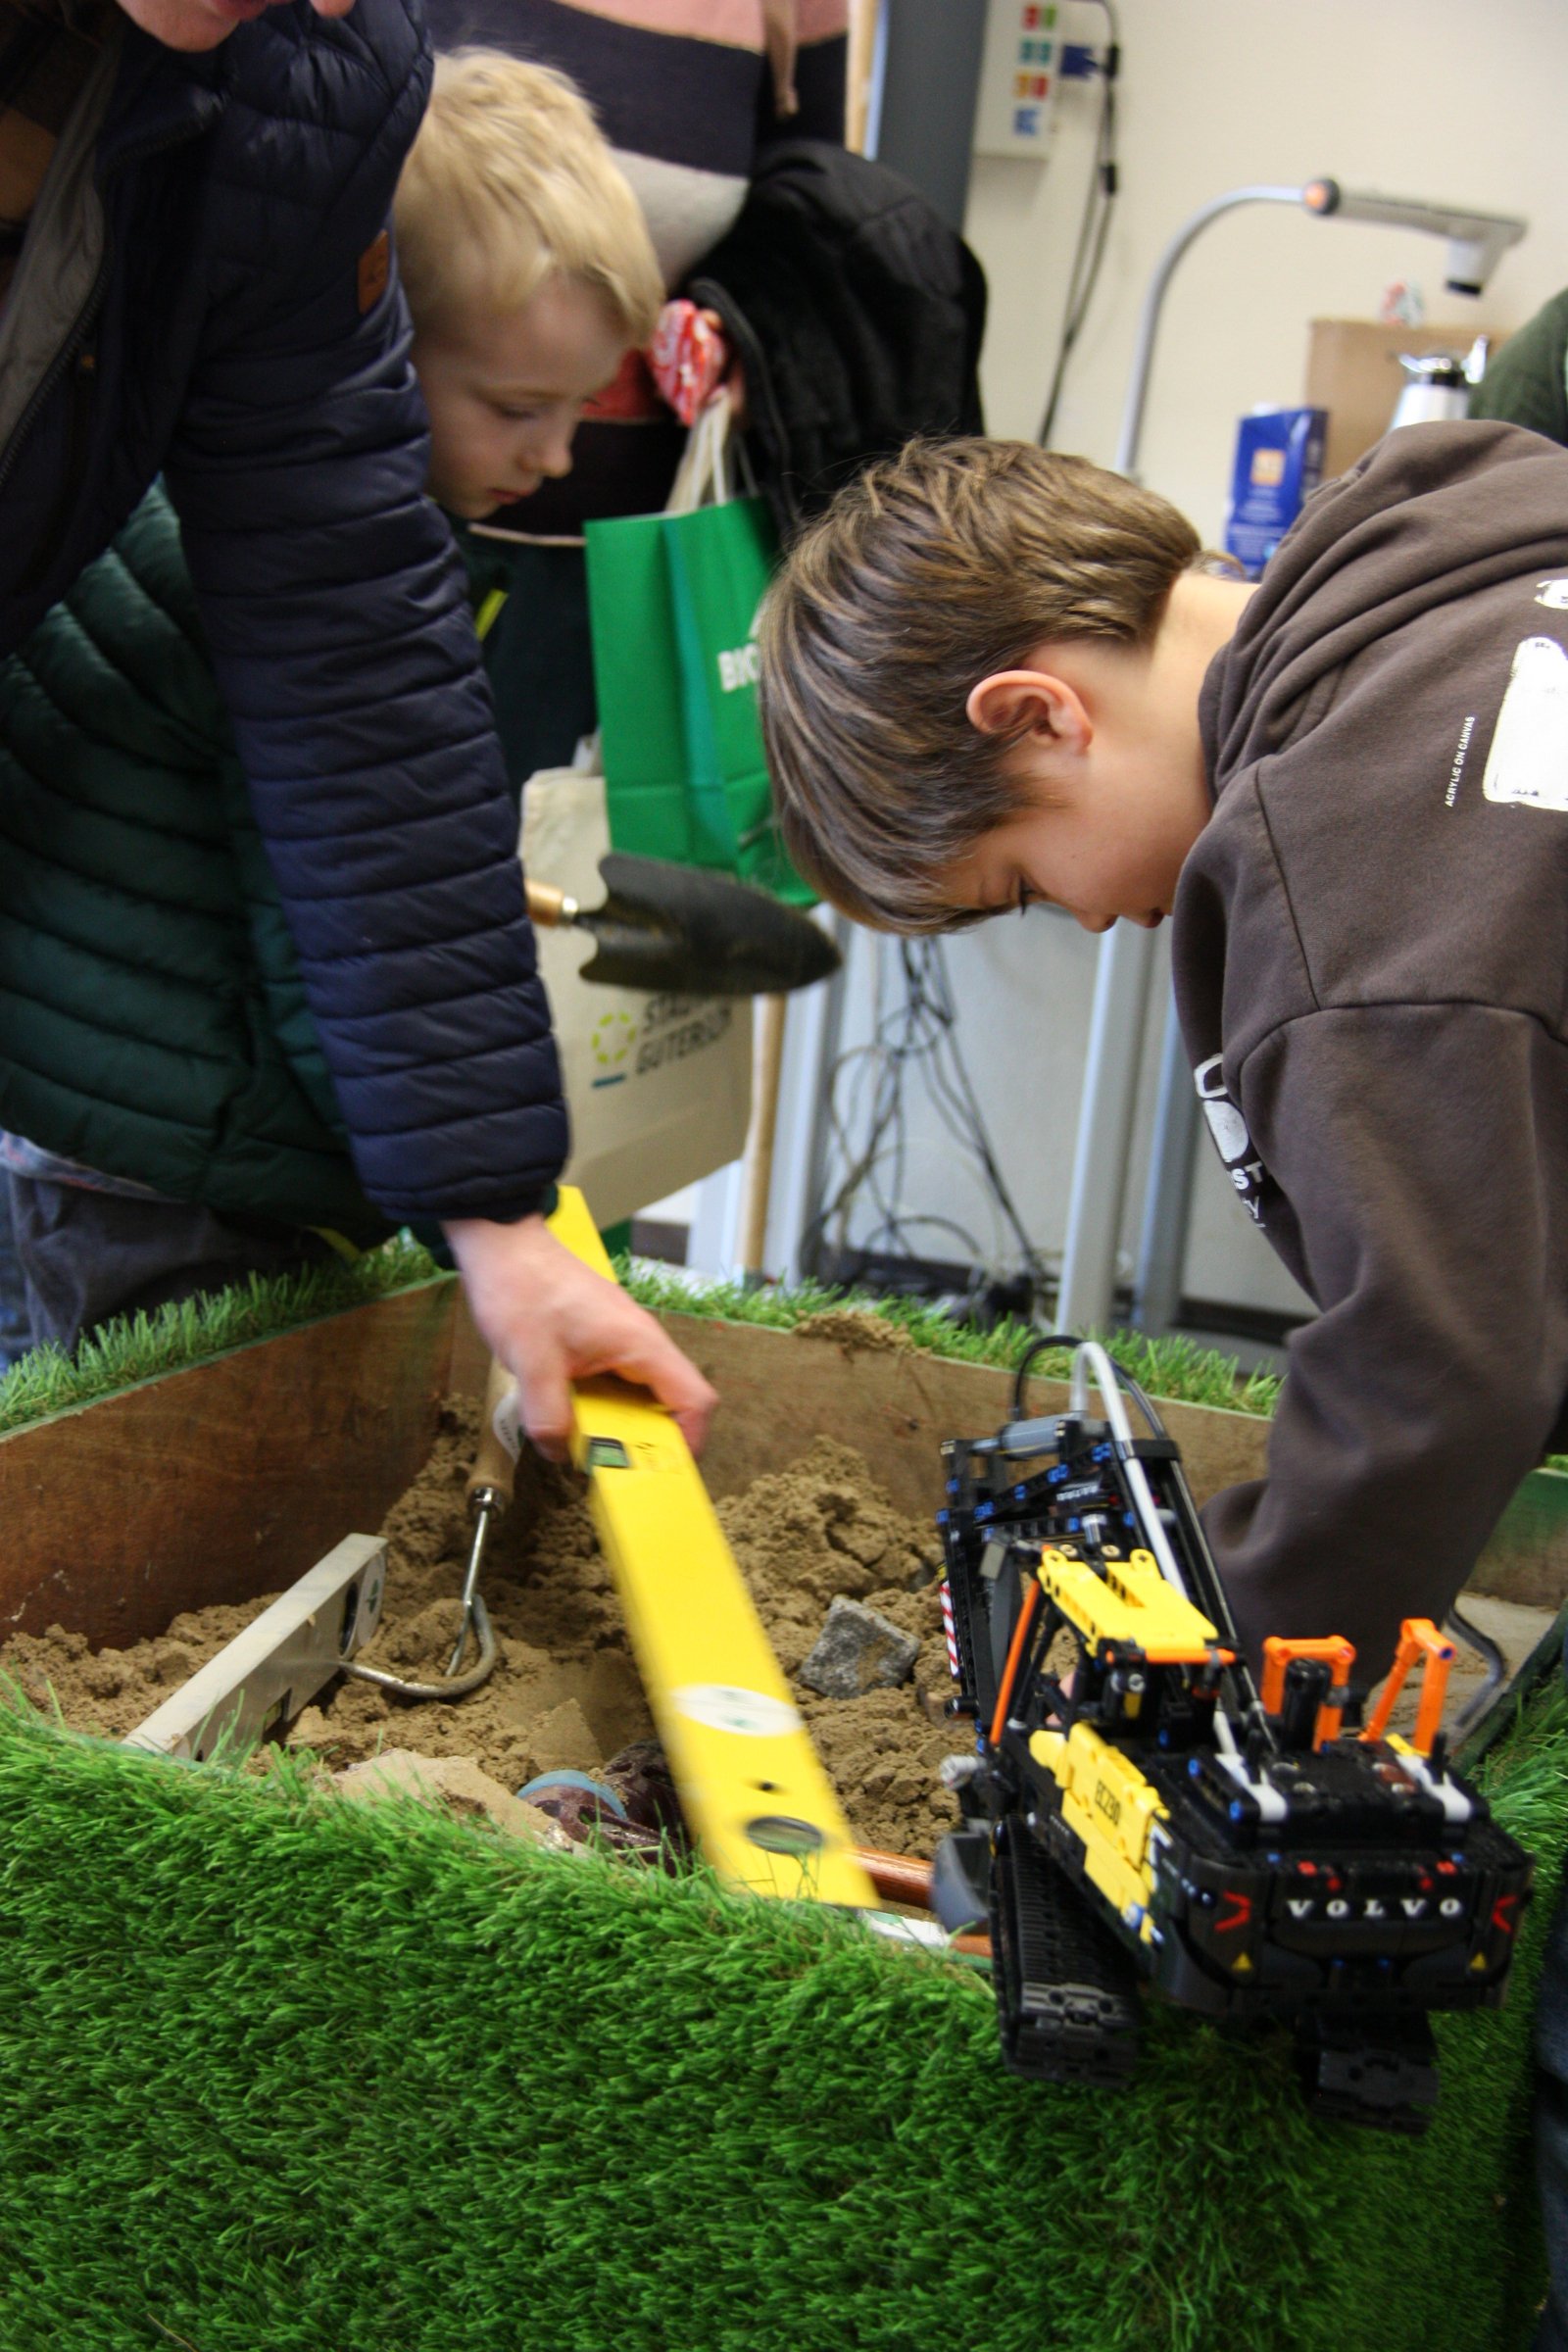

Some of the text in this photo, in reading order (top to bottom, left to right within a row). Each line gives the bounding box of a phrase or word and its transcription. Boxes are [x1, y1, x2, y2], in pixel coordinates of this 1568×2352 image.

[1445, 716, 1476, 808] ACRYLIC ON CANVAS
[1231, 1160, 1263, 1191] ST
[1095, 1778, 1121, 1827] EC230
[1286, 1897, 1463, 1919] VOLVO
